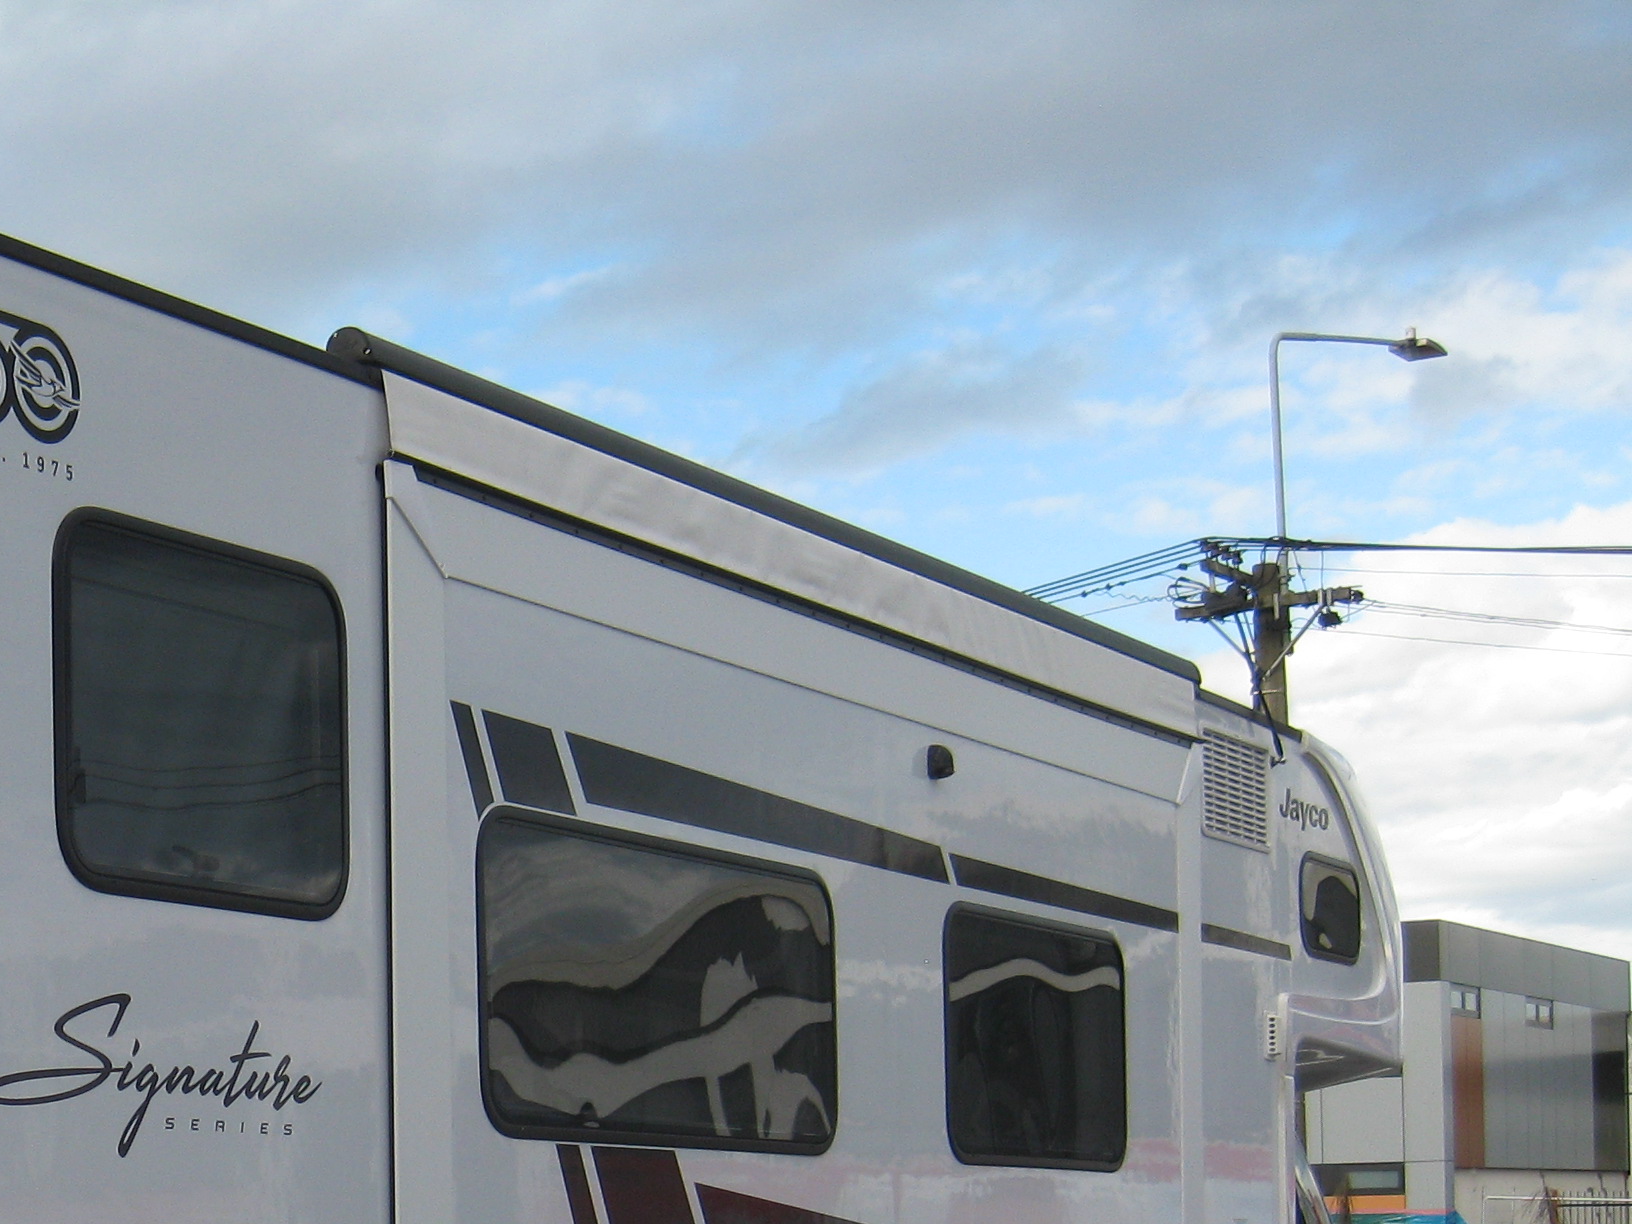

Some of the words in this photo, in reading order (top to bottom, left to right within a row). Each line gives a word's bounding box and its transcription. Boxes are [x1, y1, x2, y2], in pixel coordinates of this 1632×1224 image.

[21, 451, 74, 482] 1975
[1279, 787, 1329, 831] Jayco
[164, 1116, 294, 1136] SERIES
